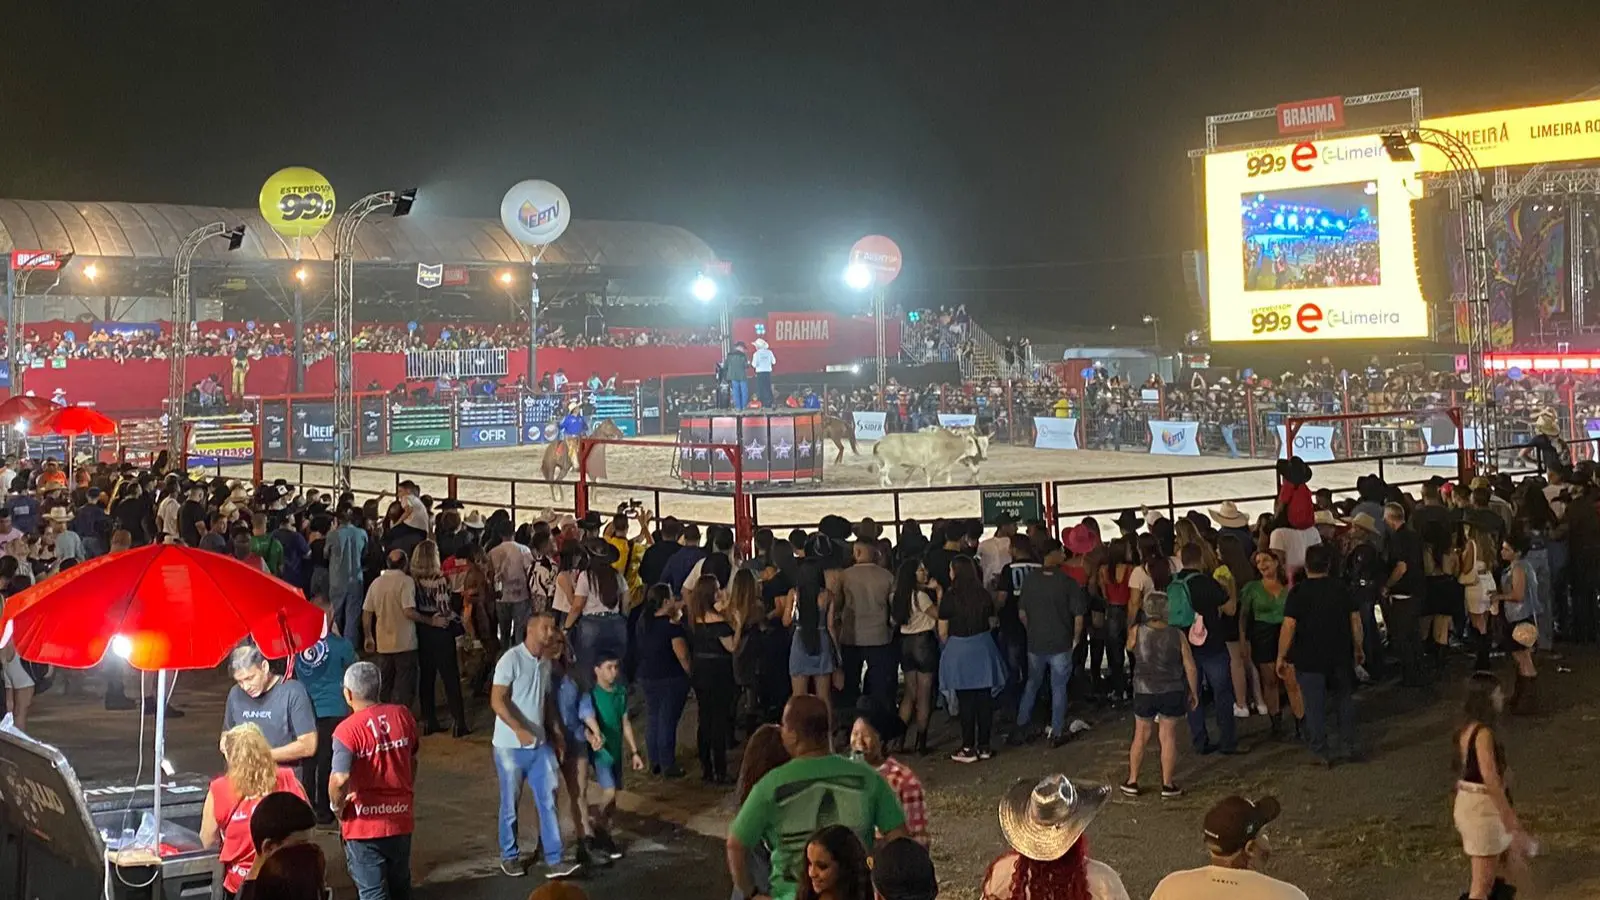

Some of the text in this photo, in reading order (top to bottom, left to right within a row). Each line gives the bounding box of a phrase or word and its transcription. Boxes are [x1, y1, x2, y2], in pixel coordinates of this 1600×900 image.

[1283, 103, 1336, 127] BRAHMA
[1530, 121, 1581, 139] LIMEIRA
[1247, 153, 1286, 177] 99.9
[529, 200, 559, 228] EPTV
[775, 320, 829, 341] BRAHMA
[1252, 312, 1291, 334] 99.9
[303, 422, 335, 438] LIMEIR
[478, 429, 505, 441] OFIR
[414, 438, 440, 447] SIDER
[1294, 435, 1326, 450] OFIR
[995, 500, 1025, 508] ARENA
[365, 714, 391, 738] 15
[354, 802, 409, 817] Vendedor
